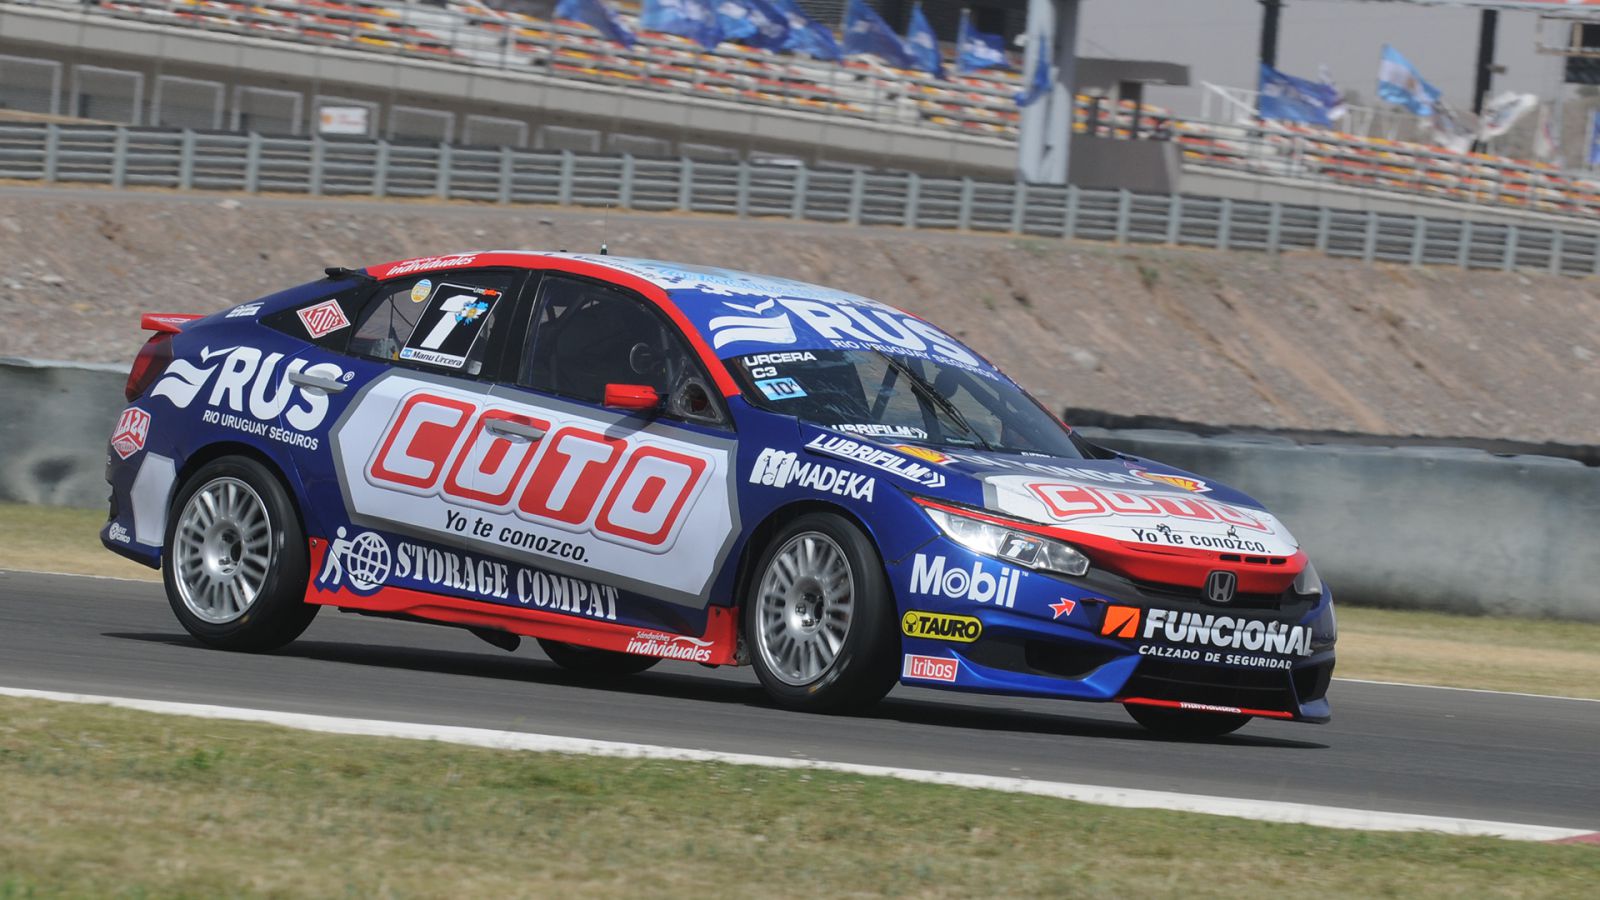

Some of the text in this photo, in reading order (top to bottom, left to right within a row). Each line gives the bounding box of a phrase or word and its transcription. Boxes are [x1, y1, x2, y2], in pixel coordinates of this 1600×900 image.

[420, 295, 479, 349] 1
[776, 298, 979, 368] RUS
[412, 351, 434, 361] Manu
[744, 352, 817, 366] URCERA
[830, 339, 860, 349] RIO
[208, 346, 344, 431] RUS
[752, 366, 777, 378] C3
[203, 409, 319, 450] RIO URUGUAY SEGUROS
[823, 424, 913, 436] UBRIFILM
[370, 393, 706, 545] COTO
[805, 433, 930, 481] LUBRIFILM
[787, 461, 875, 503] MADEKA
[1029, 484, 1267, 532] COTO
[444, 510, 590, 562] Yo te conozco.
[1132, 528, 1272, 554] Yo te conozco.
[394, 541, 620, 621] STORAGE COMPAT
[909, 553, 1020, 608] Mobil
[919, 616, 980, 640] TAURO
[1143, 608, 1314, 657] FUNCIONAL
[626, 637, 712, 662] individuales
[913, 659, 953, 679] tribos
[1138, 644, 1293, 671] CALZADO DE SEGURIDAD
